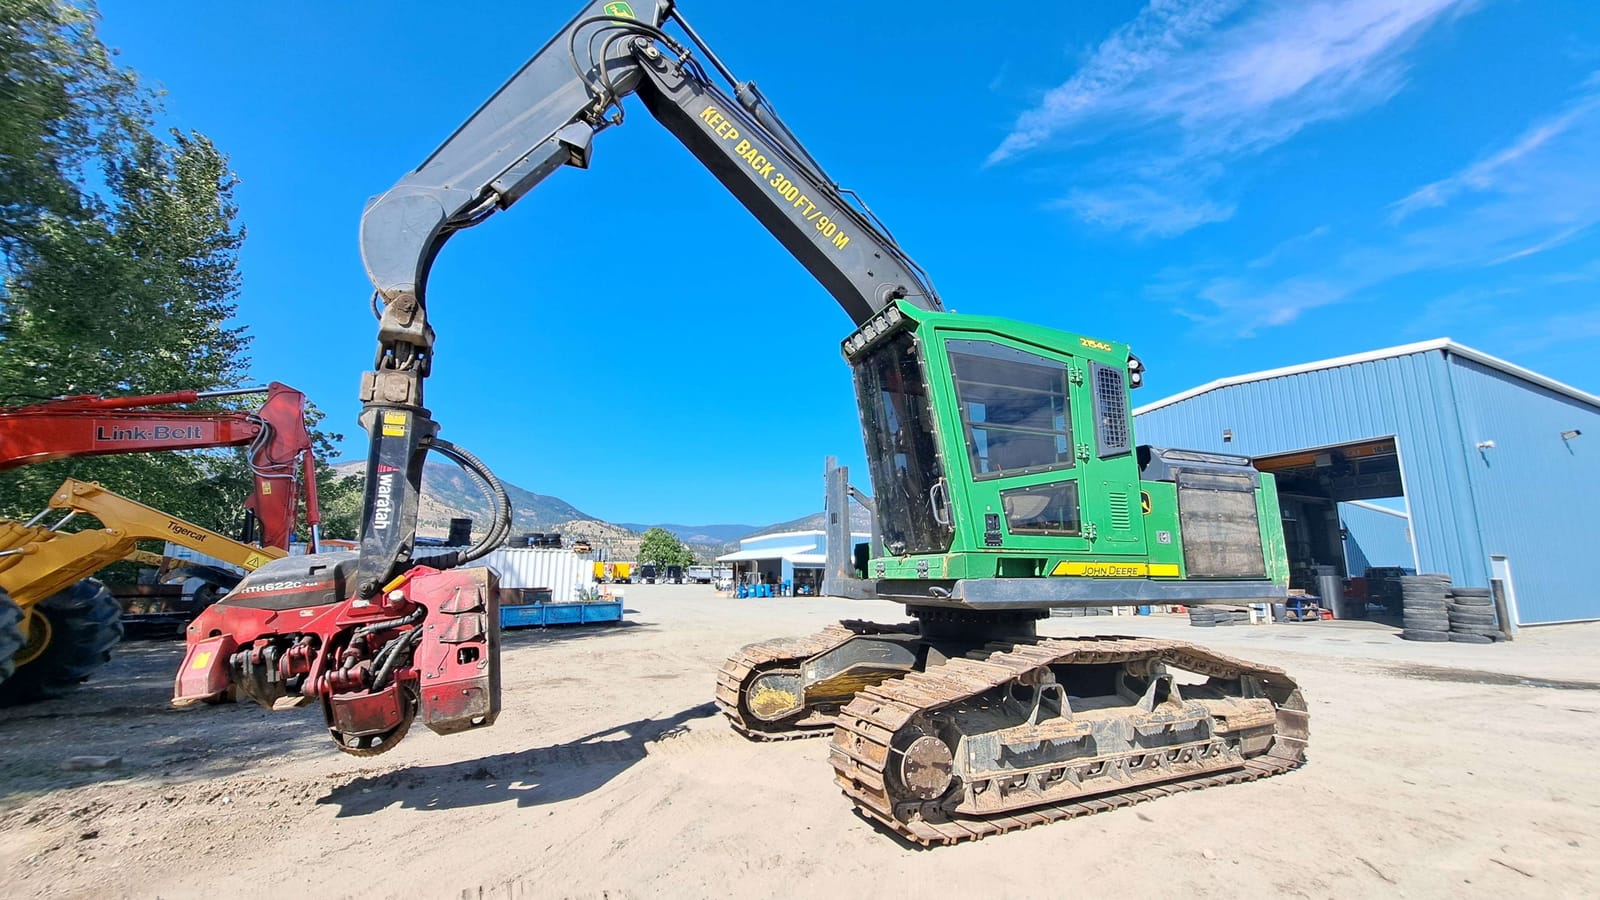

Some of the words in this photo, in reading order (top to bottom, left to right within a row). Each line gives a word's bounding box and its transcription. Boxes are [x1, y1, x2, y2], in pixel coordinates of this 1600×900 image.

[699, 105, 740, 141] KEEP
[734, 138, 776, 180] BACK
[769, 172, 800, 202] 300
[831, 231, 850, 251] M
[1079, 337, 1112, 352] 2154G
[96, 425, 202, 441] Link-Belt
[374, 474, 393, 530] waratah
[167, 520, 207, 542] Tigercat
[1081, 565, 1106, 576] JOHN
[1108, 565, 1138, 576] DEERE
